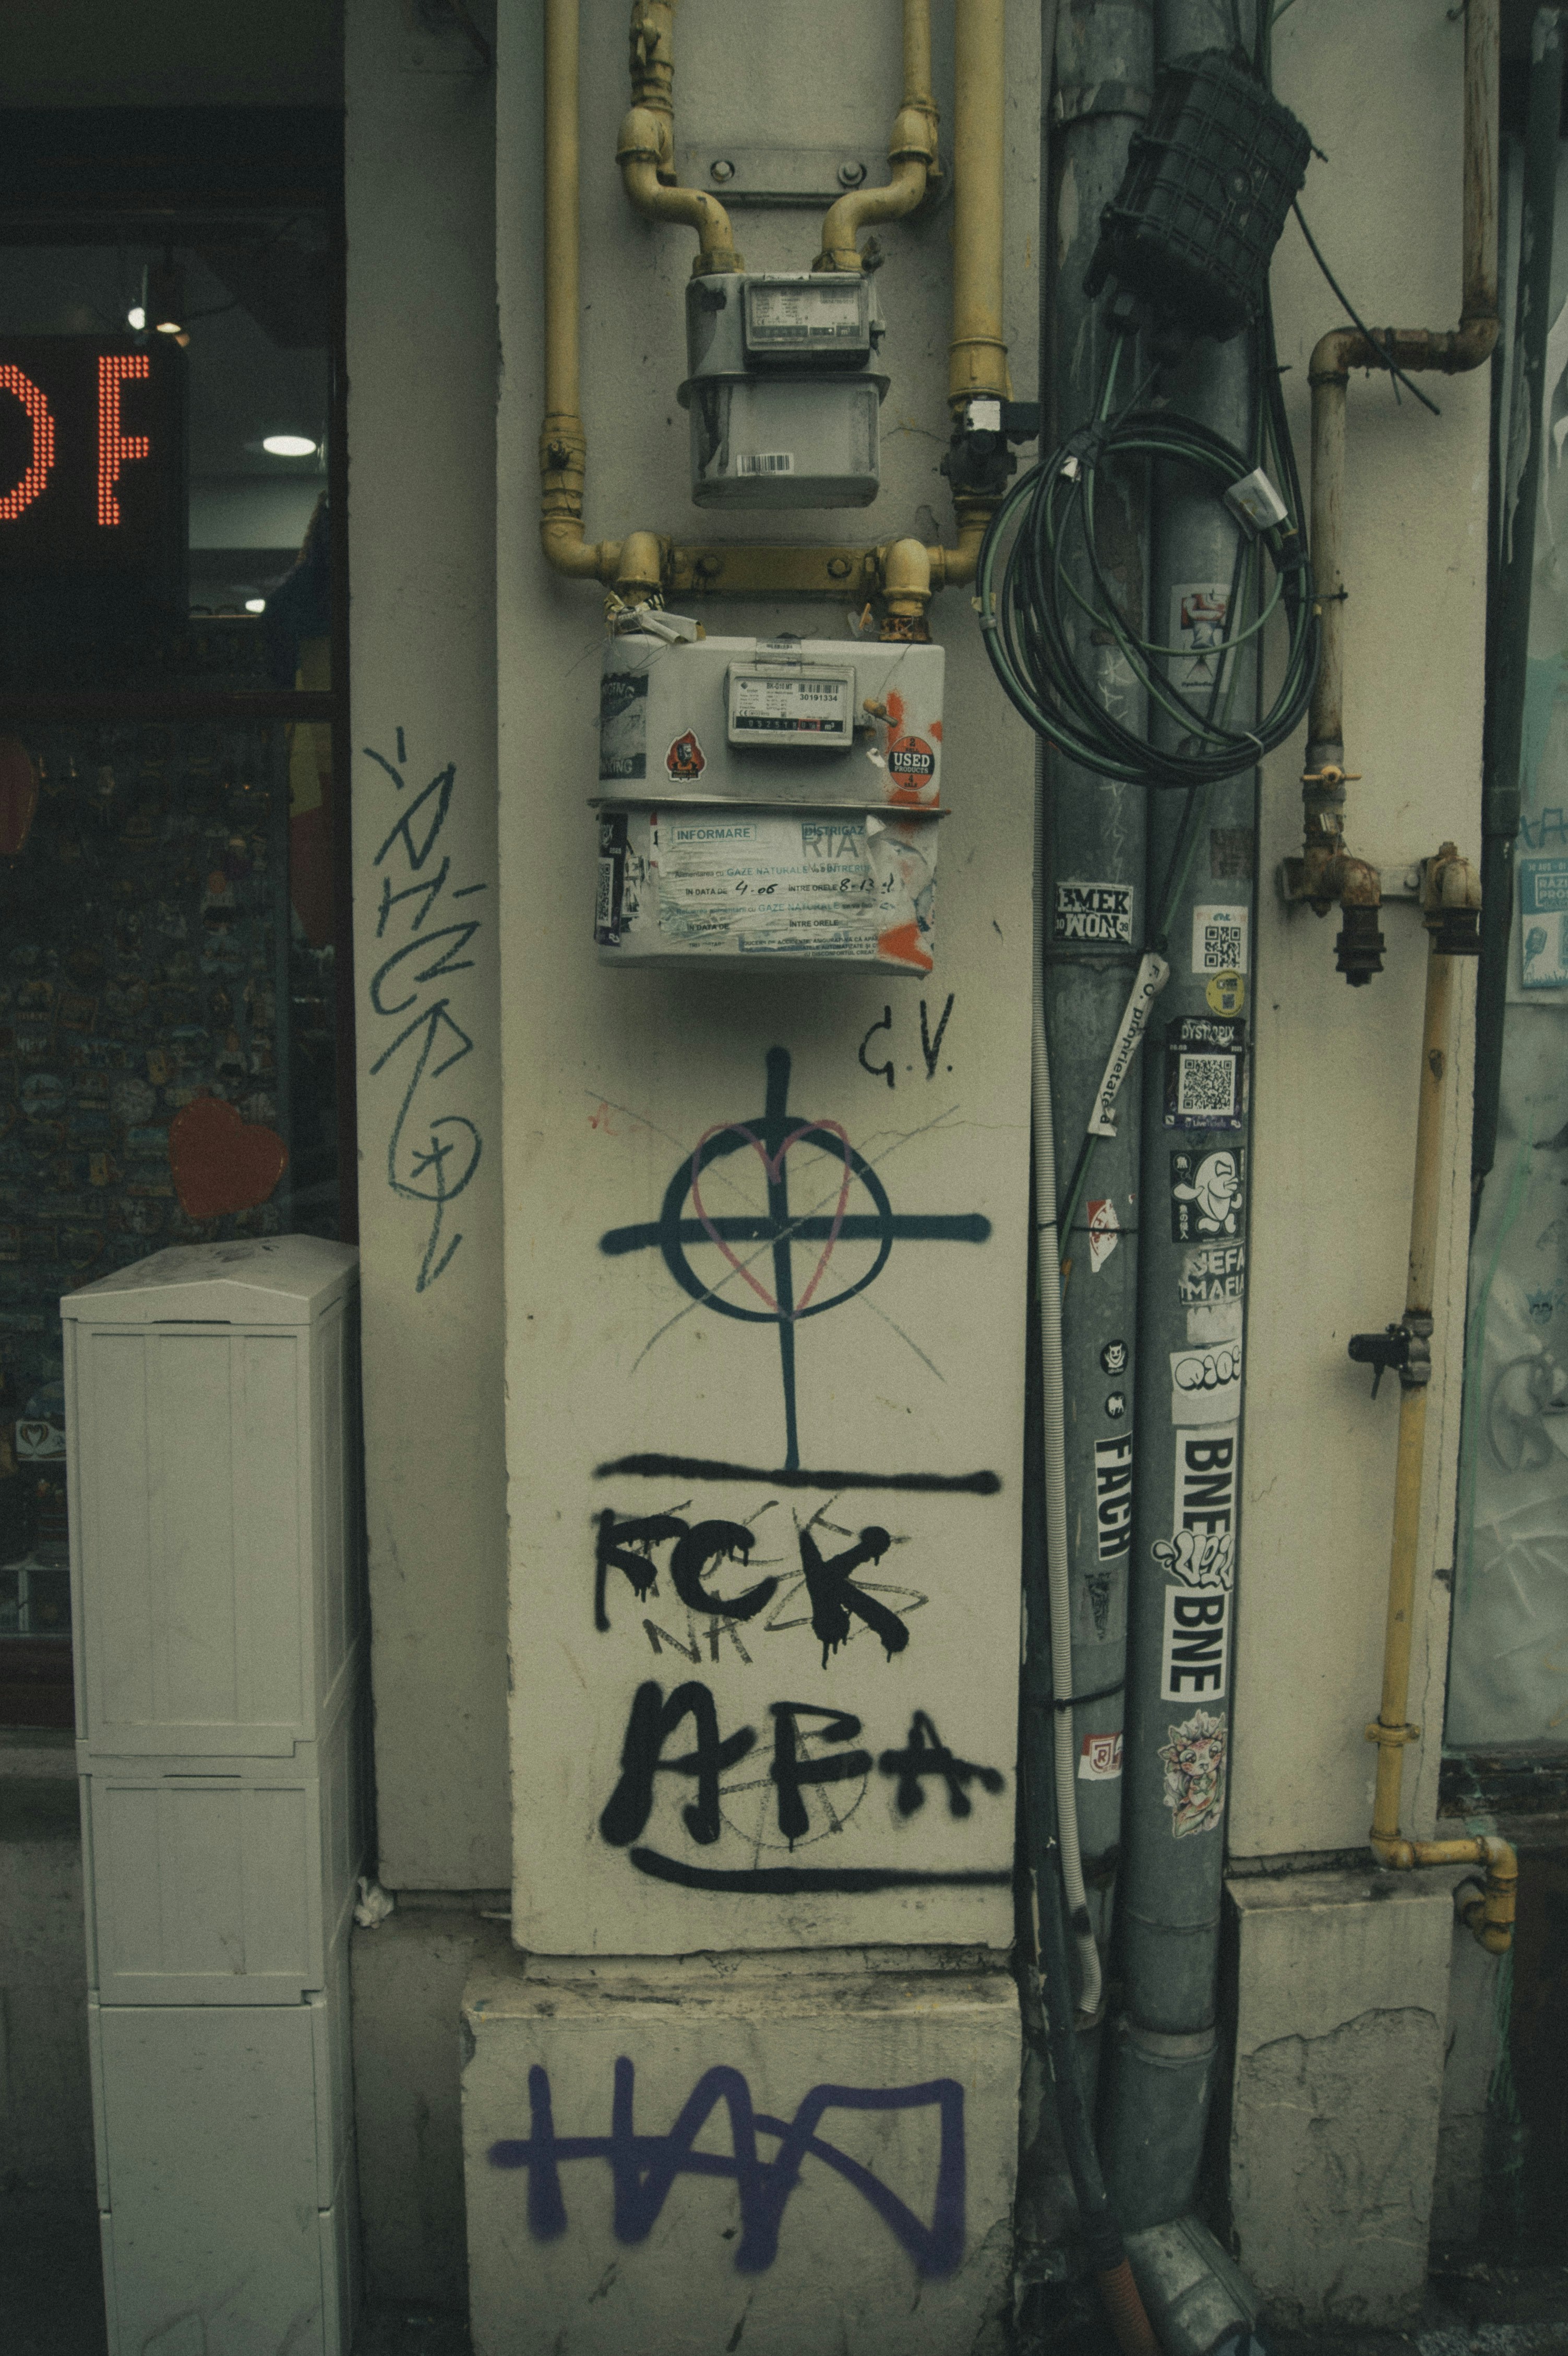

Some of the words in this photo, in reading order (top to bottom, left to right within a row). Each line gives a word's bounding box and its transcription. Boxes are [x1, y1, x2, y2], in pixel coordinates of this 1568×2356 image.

[909, 738, 916, 747] 2
[894, 752, 930, 767] USED
[677, 828, 751, 840] INFORMARE
[726, 867, 753, 877] GAZE
[756, 865, 808, 875] NATURALE
[758, 903, 785, 913] GAZE
[787, 902, 840, 911] NATURALE
[1058, 888, 1129, 914] EMEK
[1182, 1437, 1234, 1535] BNE
[1170, 1594, 1225, 1694] BNE
[600, 1679, 1005, 1852] AFA
